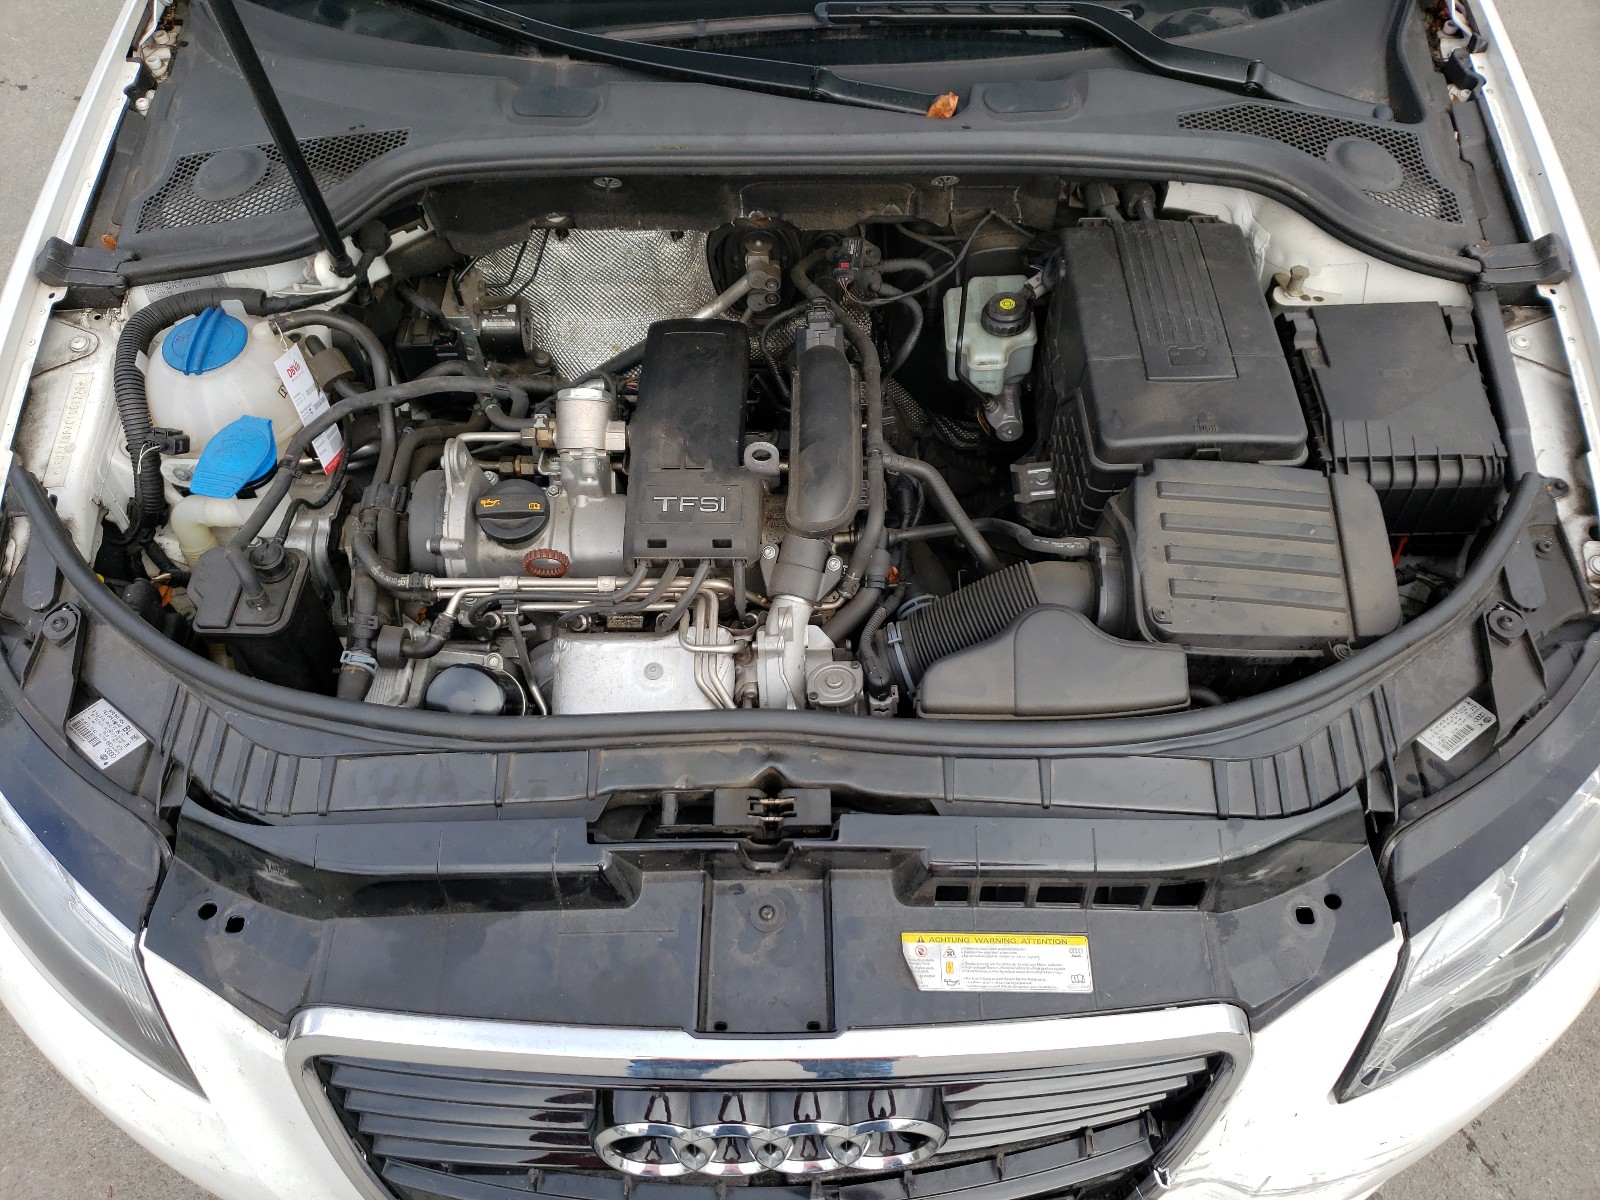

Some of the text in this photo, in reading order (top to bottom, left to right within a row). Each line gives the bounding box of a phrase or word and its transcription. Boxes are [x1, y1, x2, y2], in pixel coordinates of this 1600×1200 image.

[653, 496, 726, 512] TFSI
[928, 936, 970, 944] ACHTUNG
[1021, 937, 1068, 945] ATTENTION
